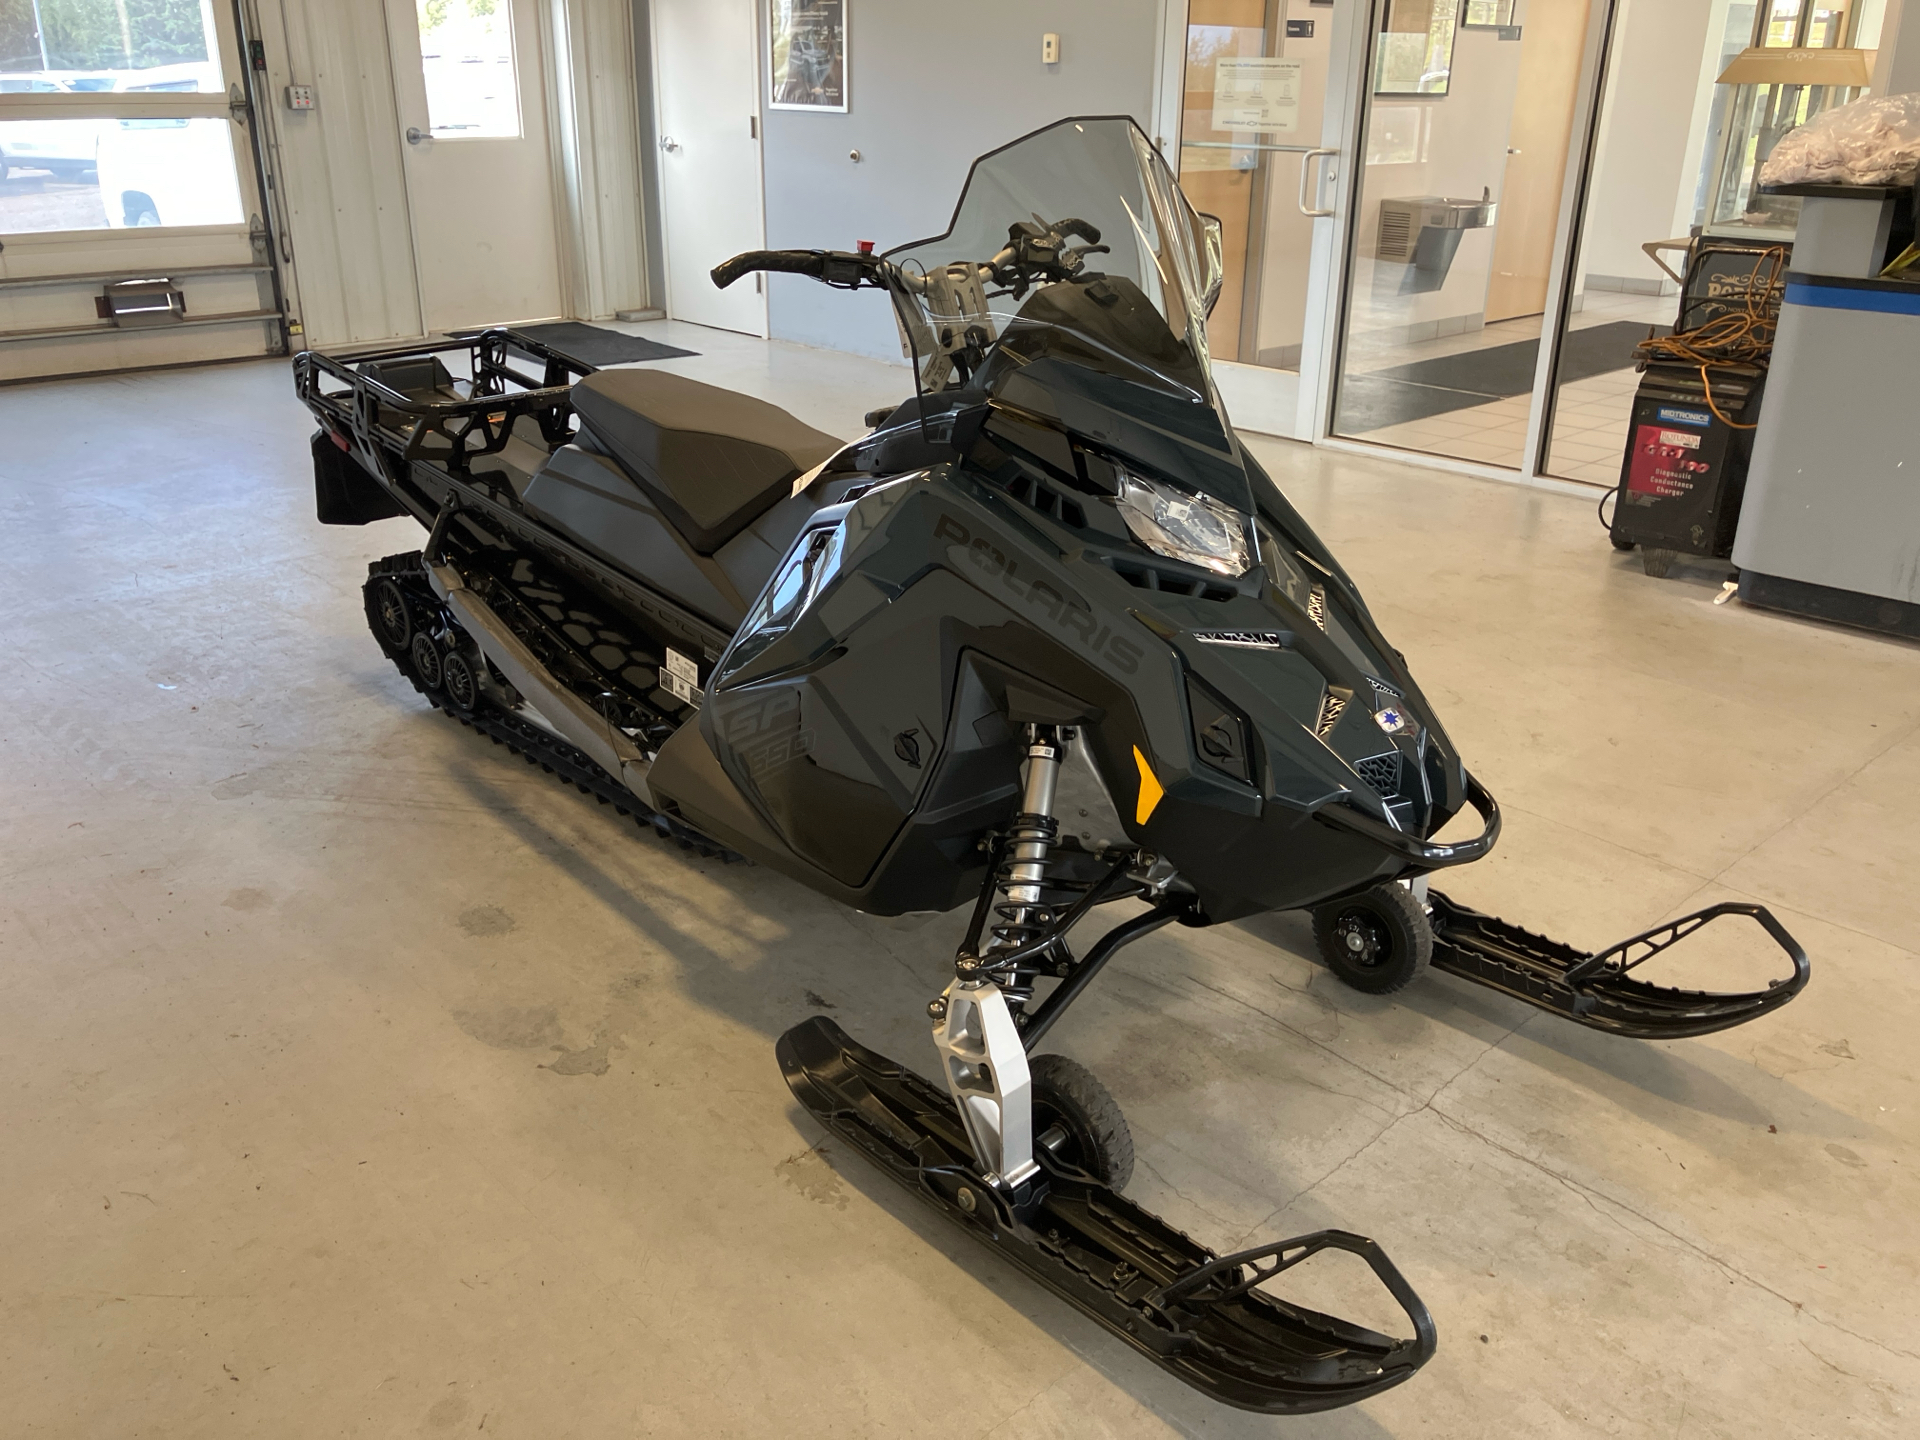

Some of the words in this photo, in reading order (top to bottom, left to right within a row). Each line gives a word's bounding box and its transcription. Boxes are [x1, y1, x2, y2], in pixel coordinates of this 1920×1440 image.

[1660, 409, 1709, 422] MIDTRONICS
[1661, 431, 1700, 443] ROTUNDA
[1655, 467, 1692, 480] Diagnostic
[1650, 476, 1694, 490] Conductance
[1656, 486, 1684, 497] Charger
[932, 512, 1145, 676] POLARIS
